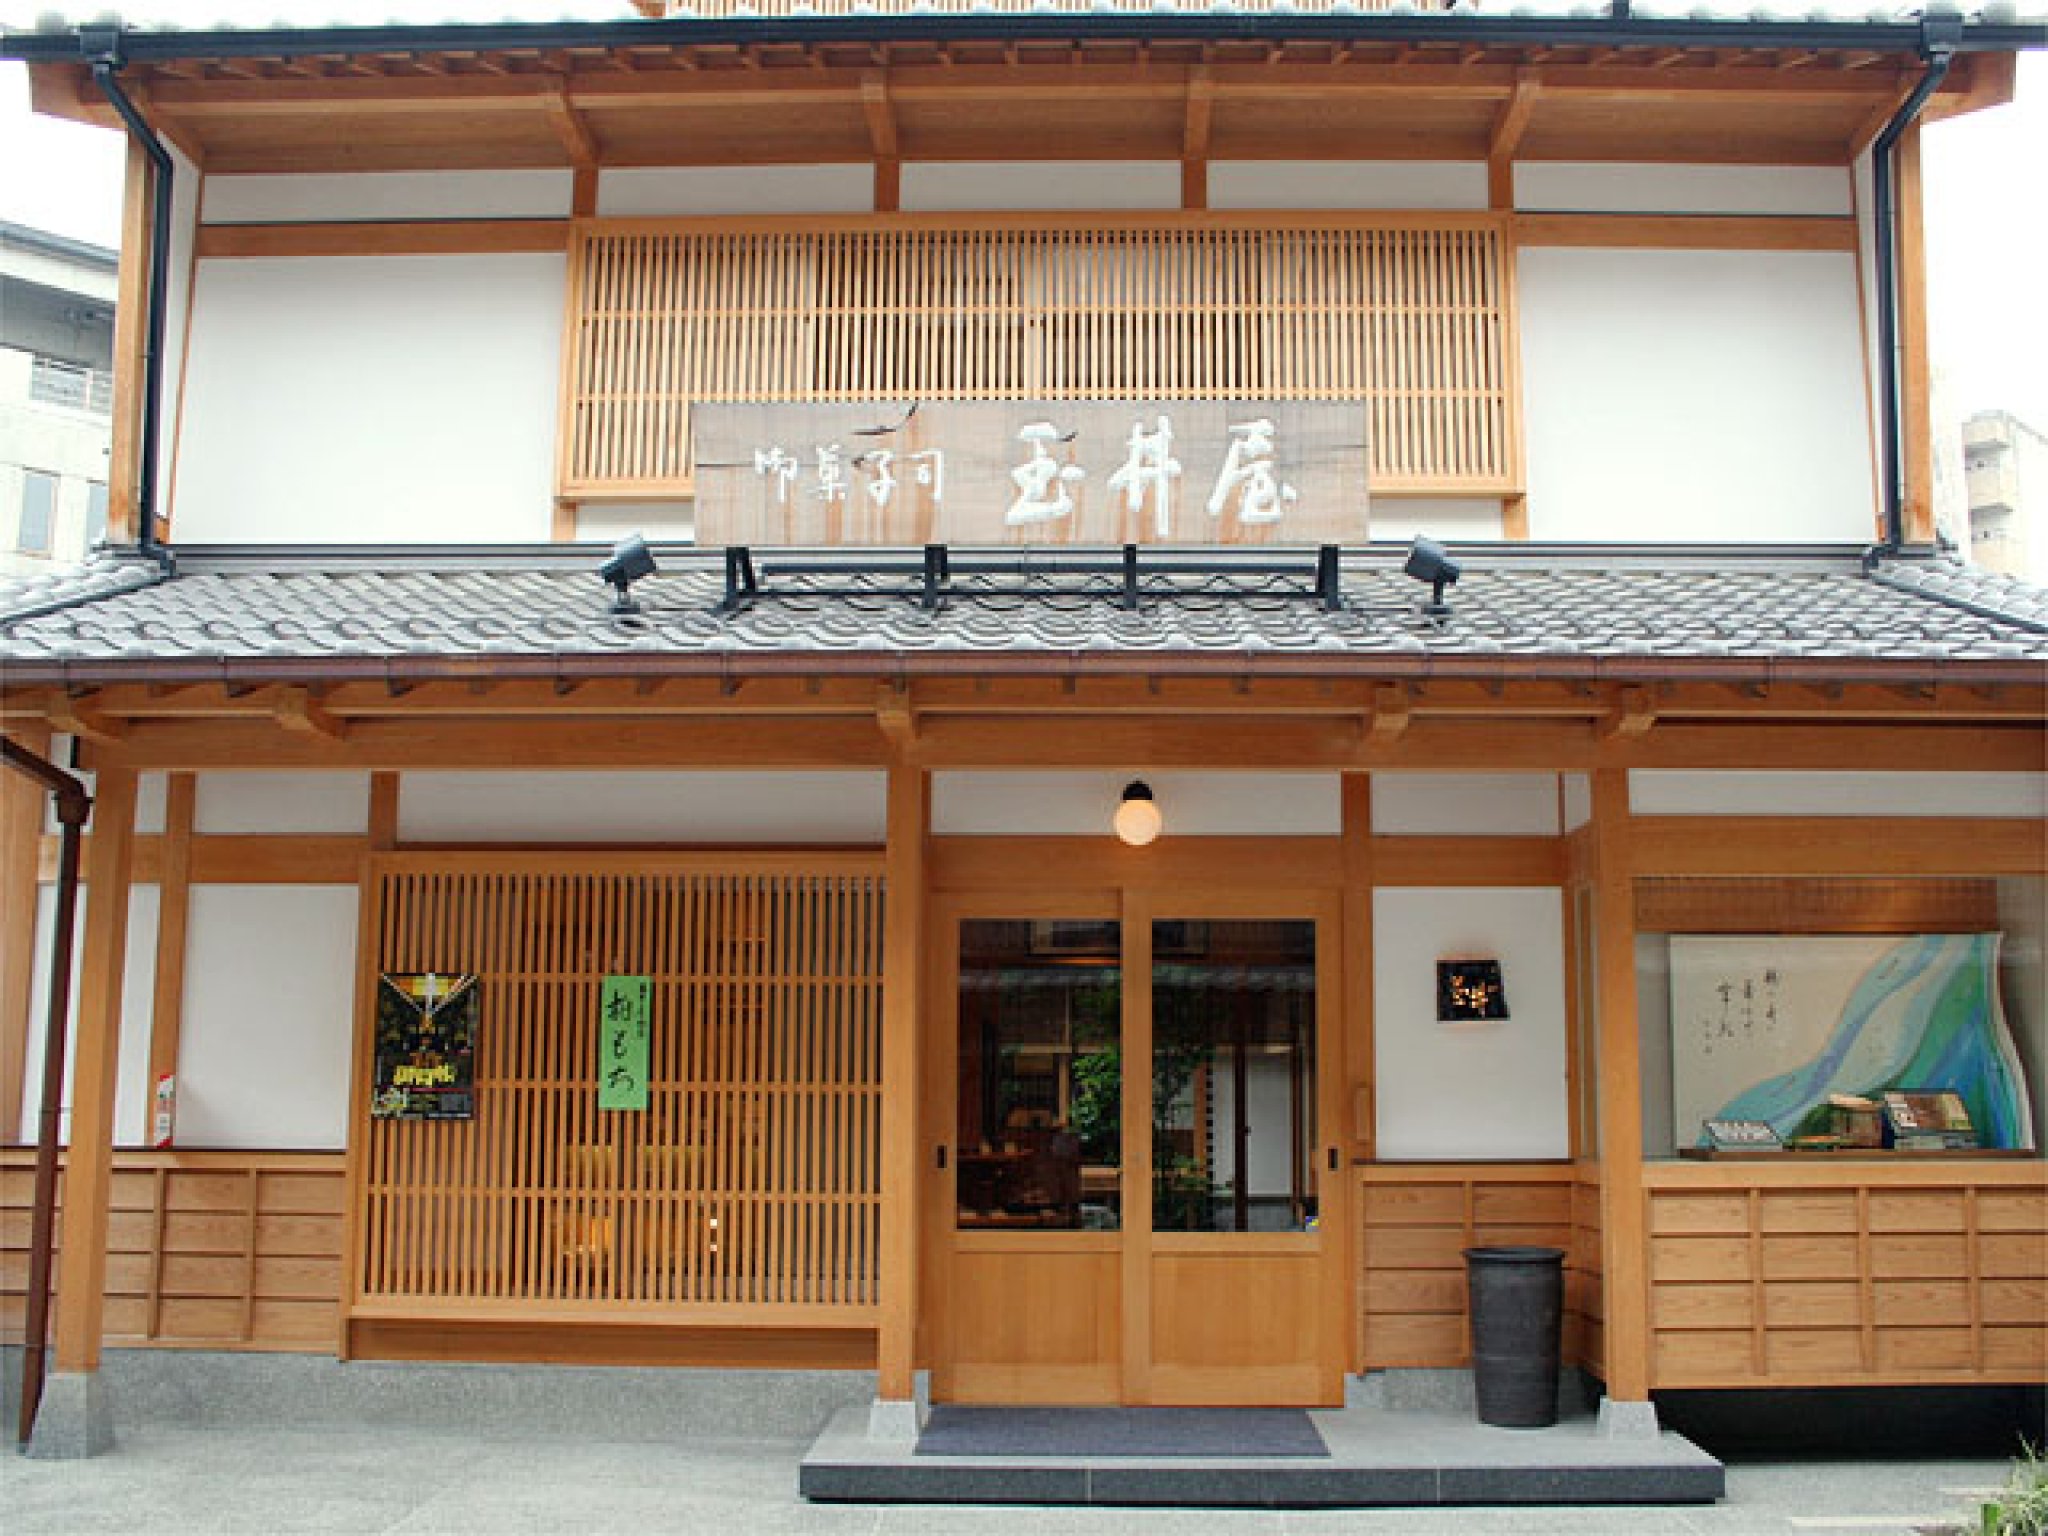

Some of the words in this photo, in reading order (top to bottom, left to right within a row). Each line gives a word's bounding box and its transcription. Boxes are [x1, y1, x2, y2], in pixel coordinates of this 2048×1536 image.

[753, 444, 944, 506] 御菓子司
[1005, 415, 1298, 537] 玉井屋
